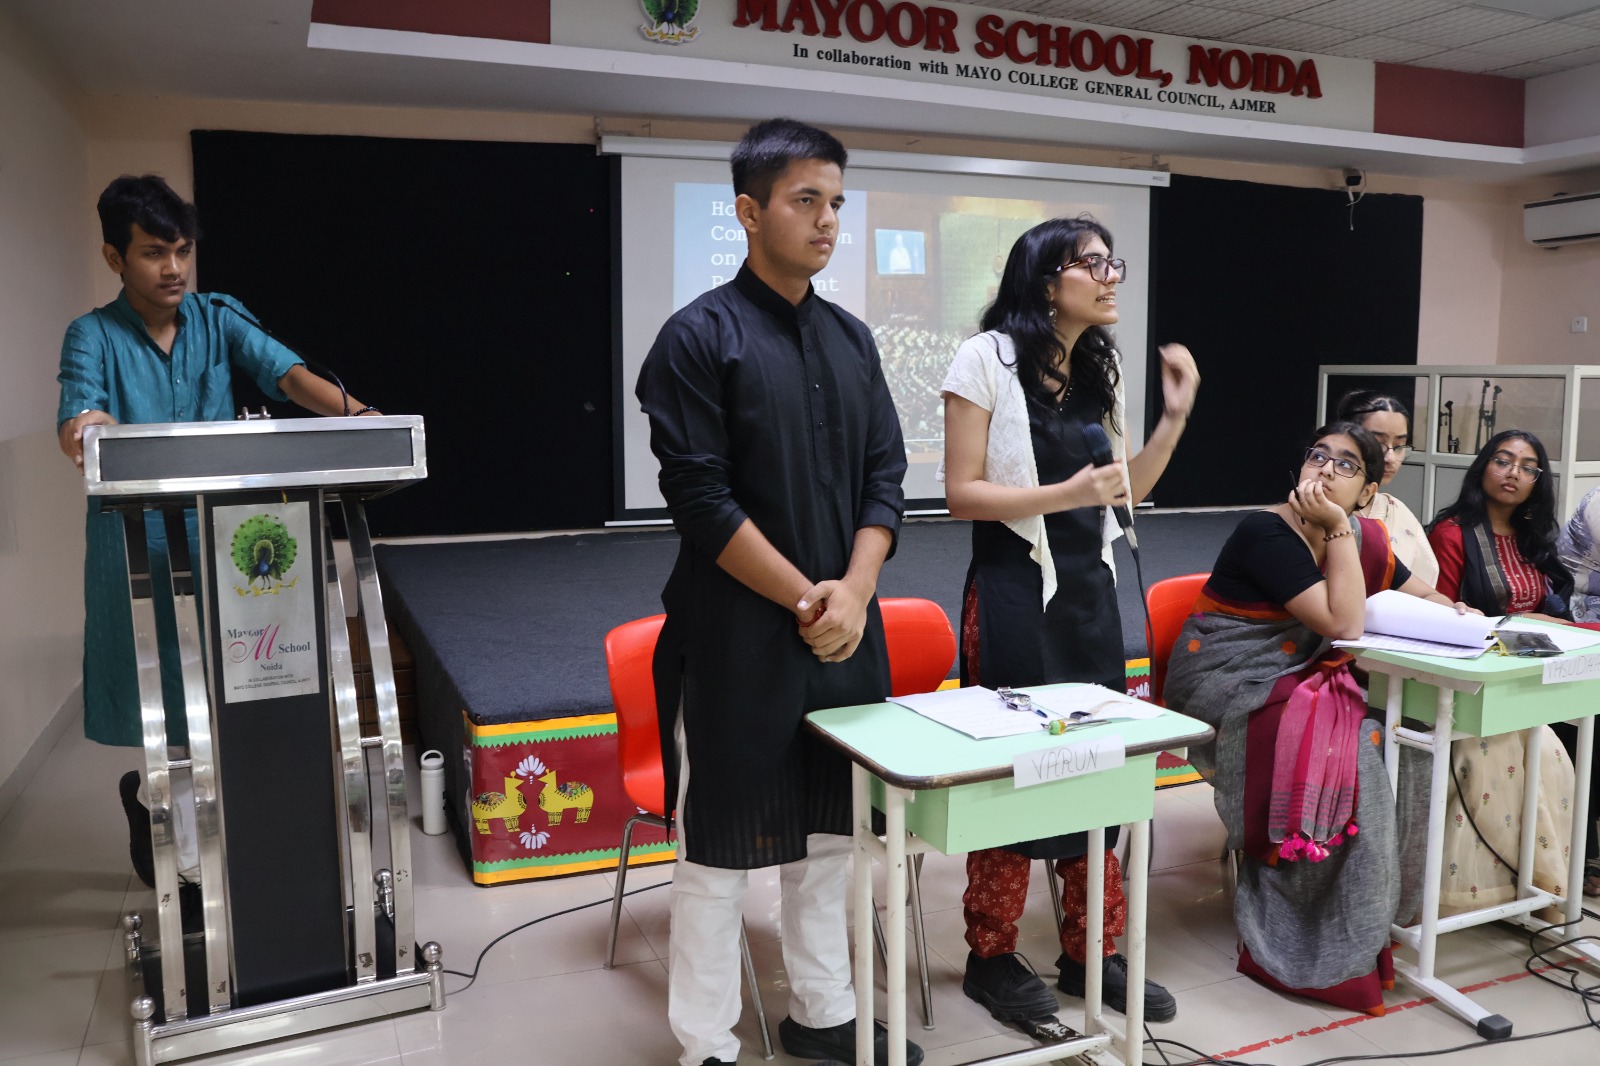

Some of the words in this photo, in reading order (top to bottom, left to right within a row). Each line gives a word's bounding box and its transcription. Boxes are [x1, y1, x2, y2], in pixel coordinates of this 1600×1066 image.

[733, 0, 960, 54] MAYOOR
[974, 14, 1173, 88] SCHOOL,
[1186, 44, 1322, 99] NOIDA
[792, 43, 809, 58] In
[816, 48, 912, 71] collaboration
[919, 60, 949, 75] with
[955, 63, 1002, 82] MAYO
[1008, 69, 1079, 91] COLLEGE
[1085, 80, 1152, 101] GENERAL
[1157, 90, 1225, 110] COUNCIL,
[1229, 98, 1277, 114] AJMER
[711, 253, 737, 266] on
[278, 641, 311, 654] School
[260, 662, 283, 672] Noida
[1032, 745, 1099, 780] VARUN
